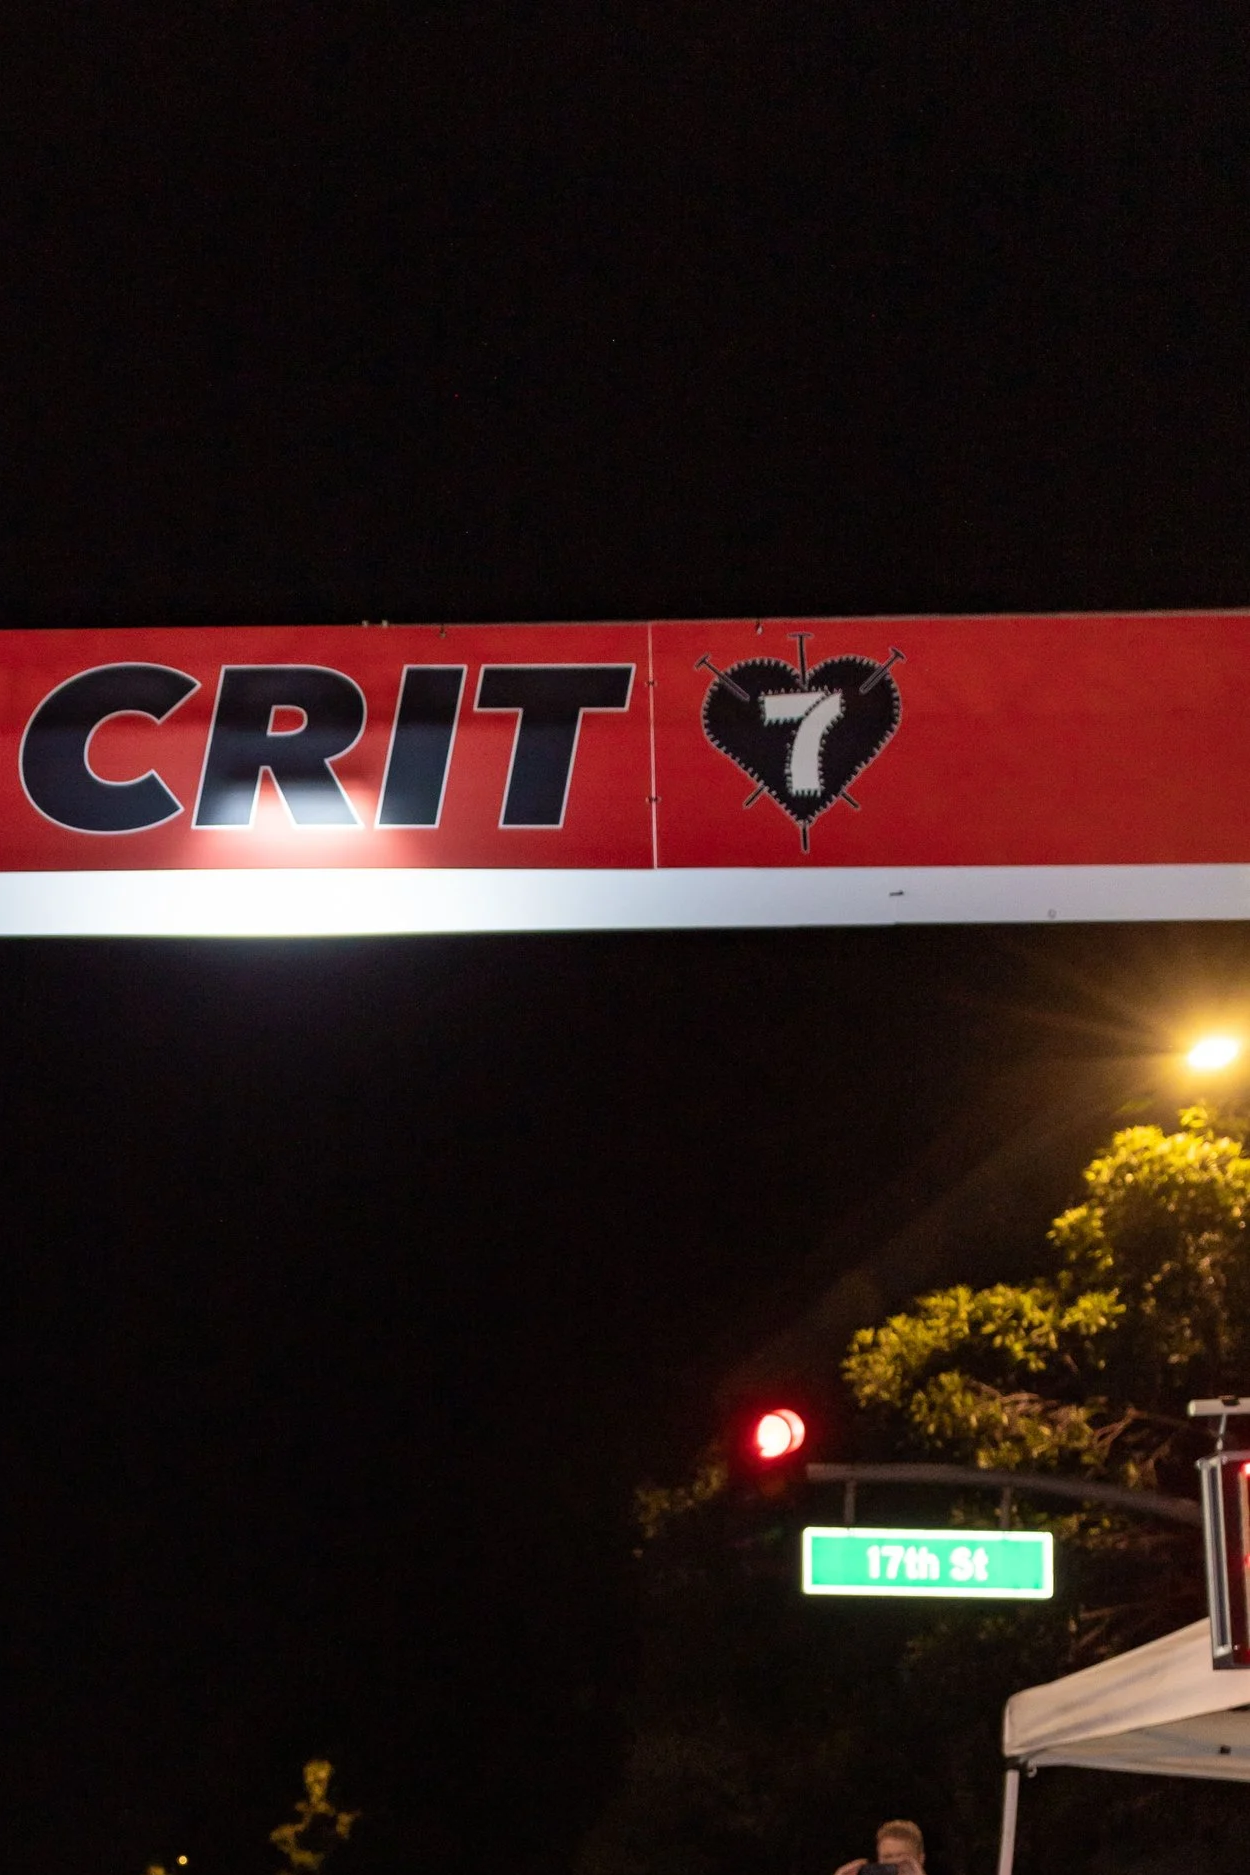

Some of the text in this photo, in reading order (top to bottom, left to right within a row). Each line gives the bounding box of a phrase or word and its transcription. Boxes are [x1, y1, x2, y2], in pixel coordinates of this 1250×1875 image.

[18, 661, 636, 835] CRIT
[763, 689, 845, 797] 7
[866, 1545, 988, 1581] 17th St
